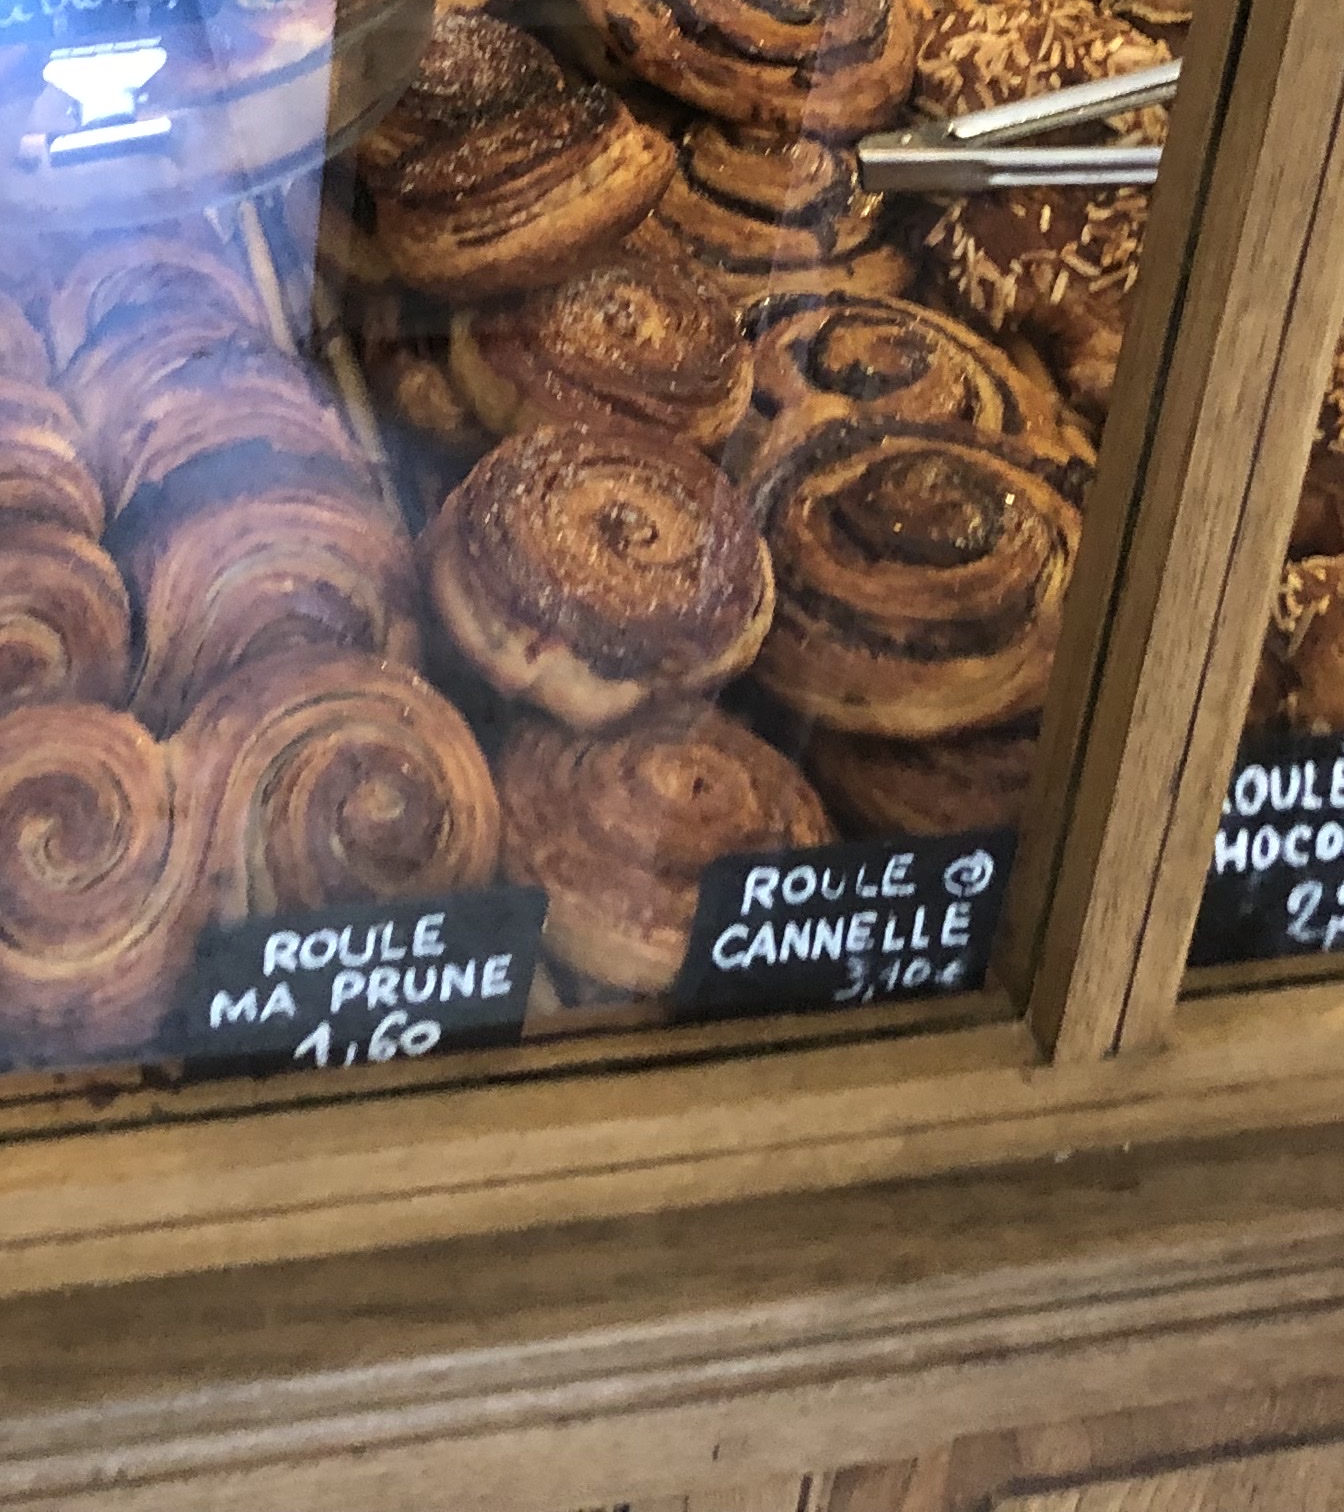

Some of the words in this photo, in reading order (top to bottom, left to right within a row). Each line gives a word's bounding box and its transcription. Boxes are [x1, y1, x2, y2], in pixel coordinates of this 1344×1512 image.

[741, 852, 916, 916] ROULE
[263, 911, 447, 977] ROULE
[711, 901, 973, 971] CANNELLE
[209, 981, 297, 1029] MA
[330, 953, 513, 1014] PRUNE
[293, 1009, 442, 1068] 1,60
